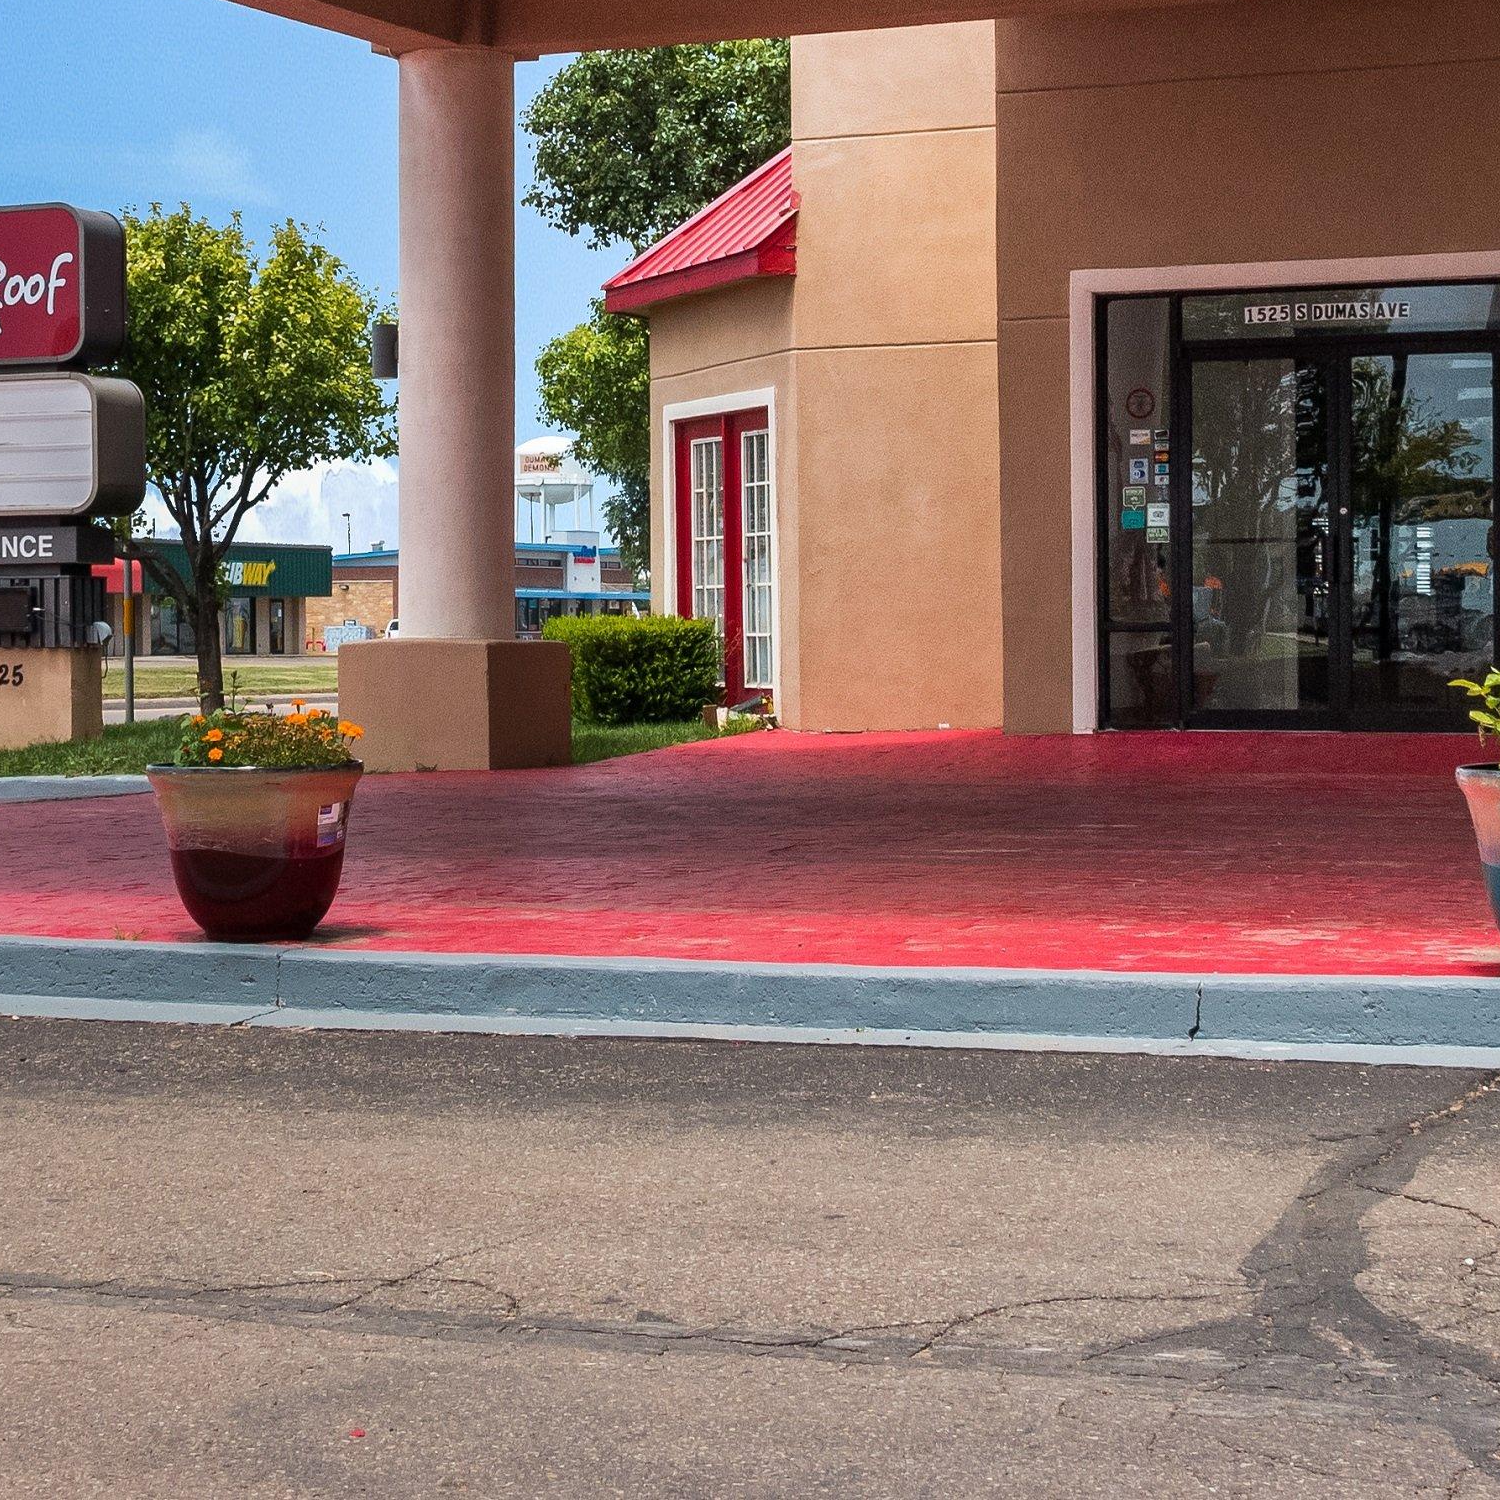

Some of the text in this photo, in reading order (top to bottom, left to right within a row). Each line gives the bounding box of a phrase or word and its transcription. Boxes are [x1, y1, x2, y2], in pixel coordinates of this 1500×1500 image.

[1246, 303, 1409, 323] 1525 S DUMAS AVE
